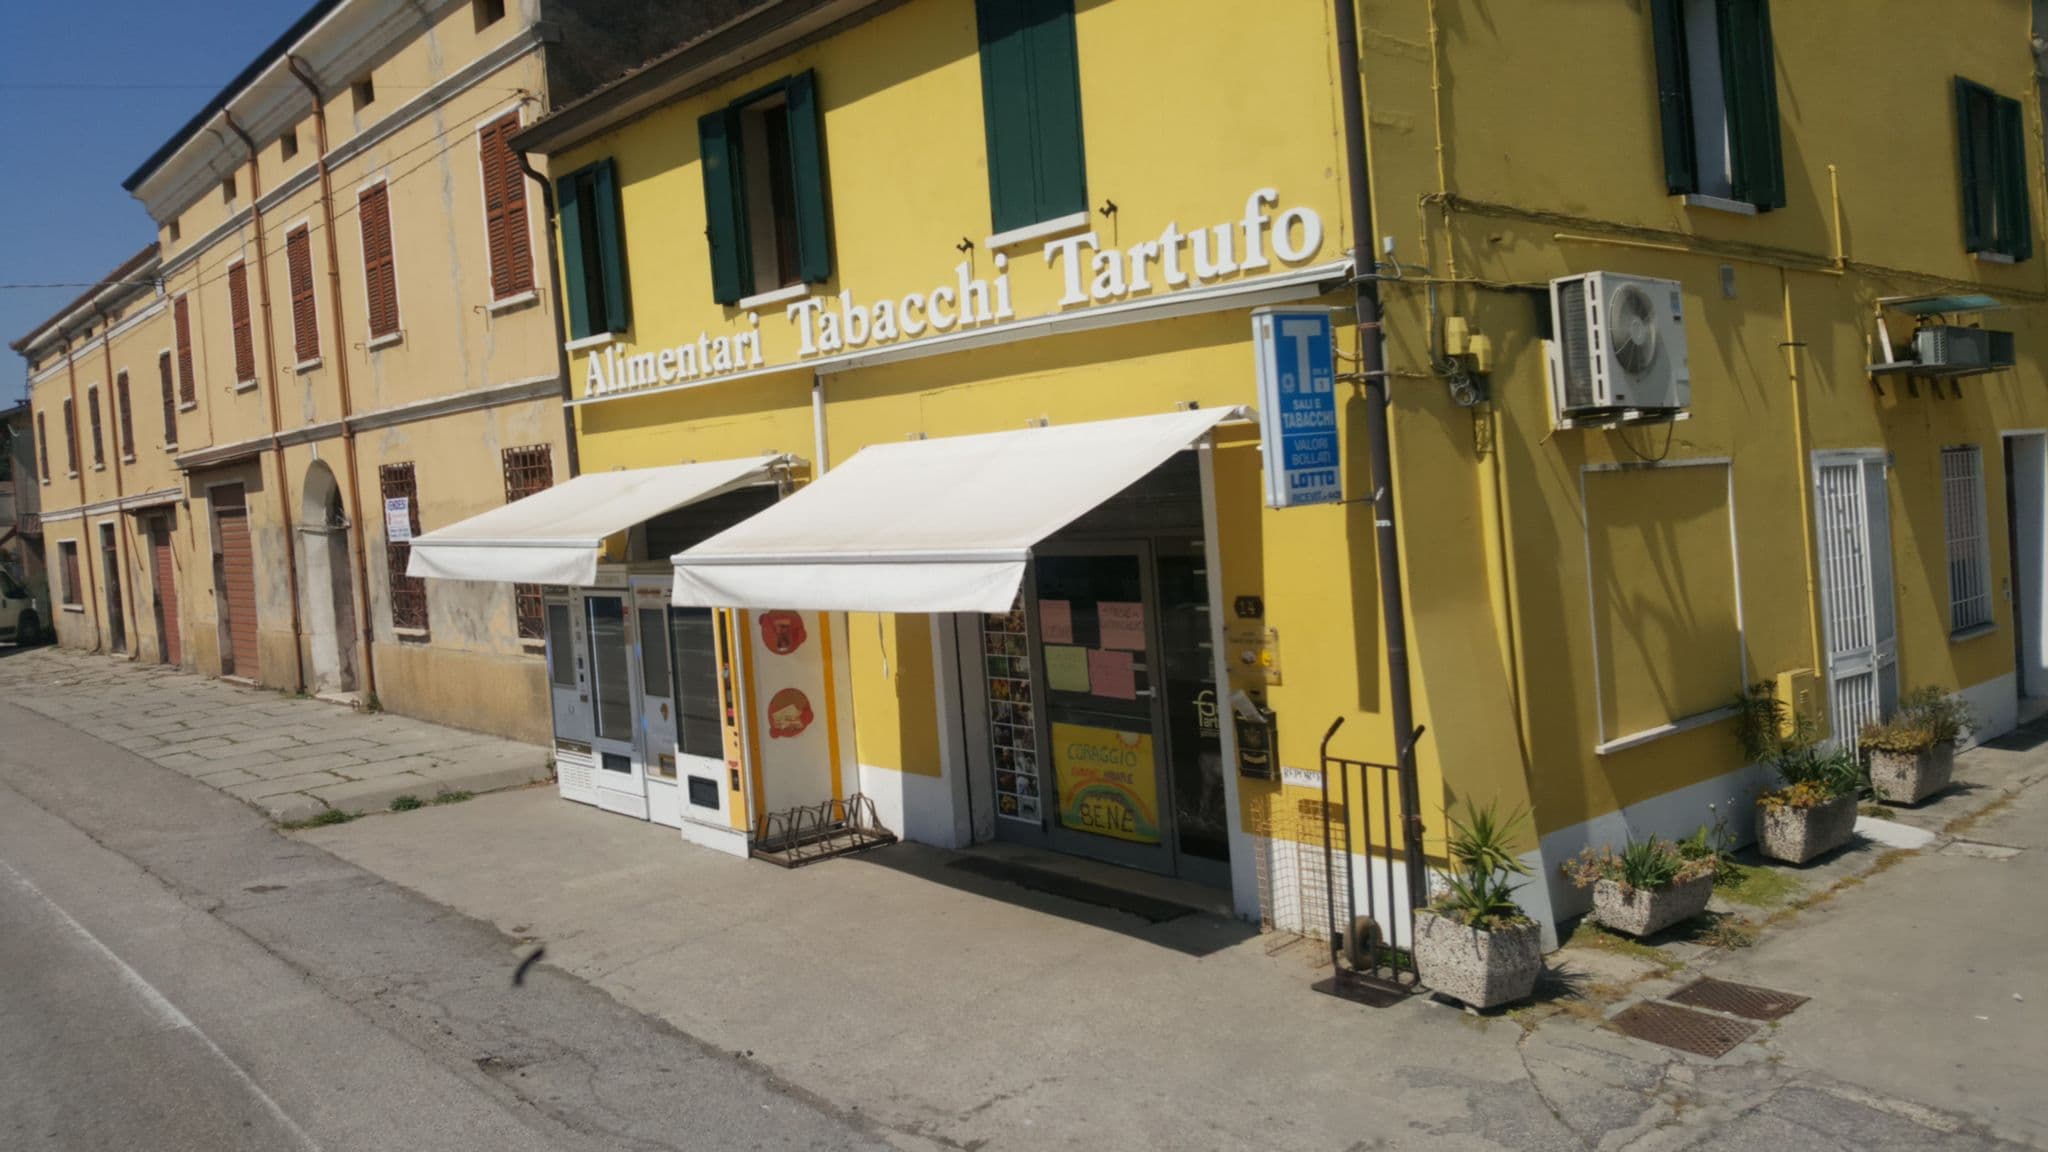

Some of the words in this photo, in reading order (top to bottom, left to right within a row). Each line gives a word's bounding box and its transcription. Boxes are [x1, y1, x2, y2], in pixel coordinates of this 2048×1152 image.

[583, 313, 764, 398] Alimentari
[786, 252, 1014, 358] Tabacchi
[1043, 187, 1326, 308] Tartufo
[1282, 319, 1323, 394] T
[1293, 400, 1313, 410] SALI
[1314, 399, 1321, 408] E
[1283, 410, 1334, 429] TABACCHI
[1294, 439, 1329, 452] VALORI
[1291, 450, 1331, 466] BOLLATI
[1290, 470, 1336, 489] LOTTO
[1067, 742, 1137, 768] CORAGGIO
[1080, 802, 1136, 832] BENE
